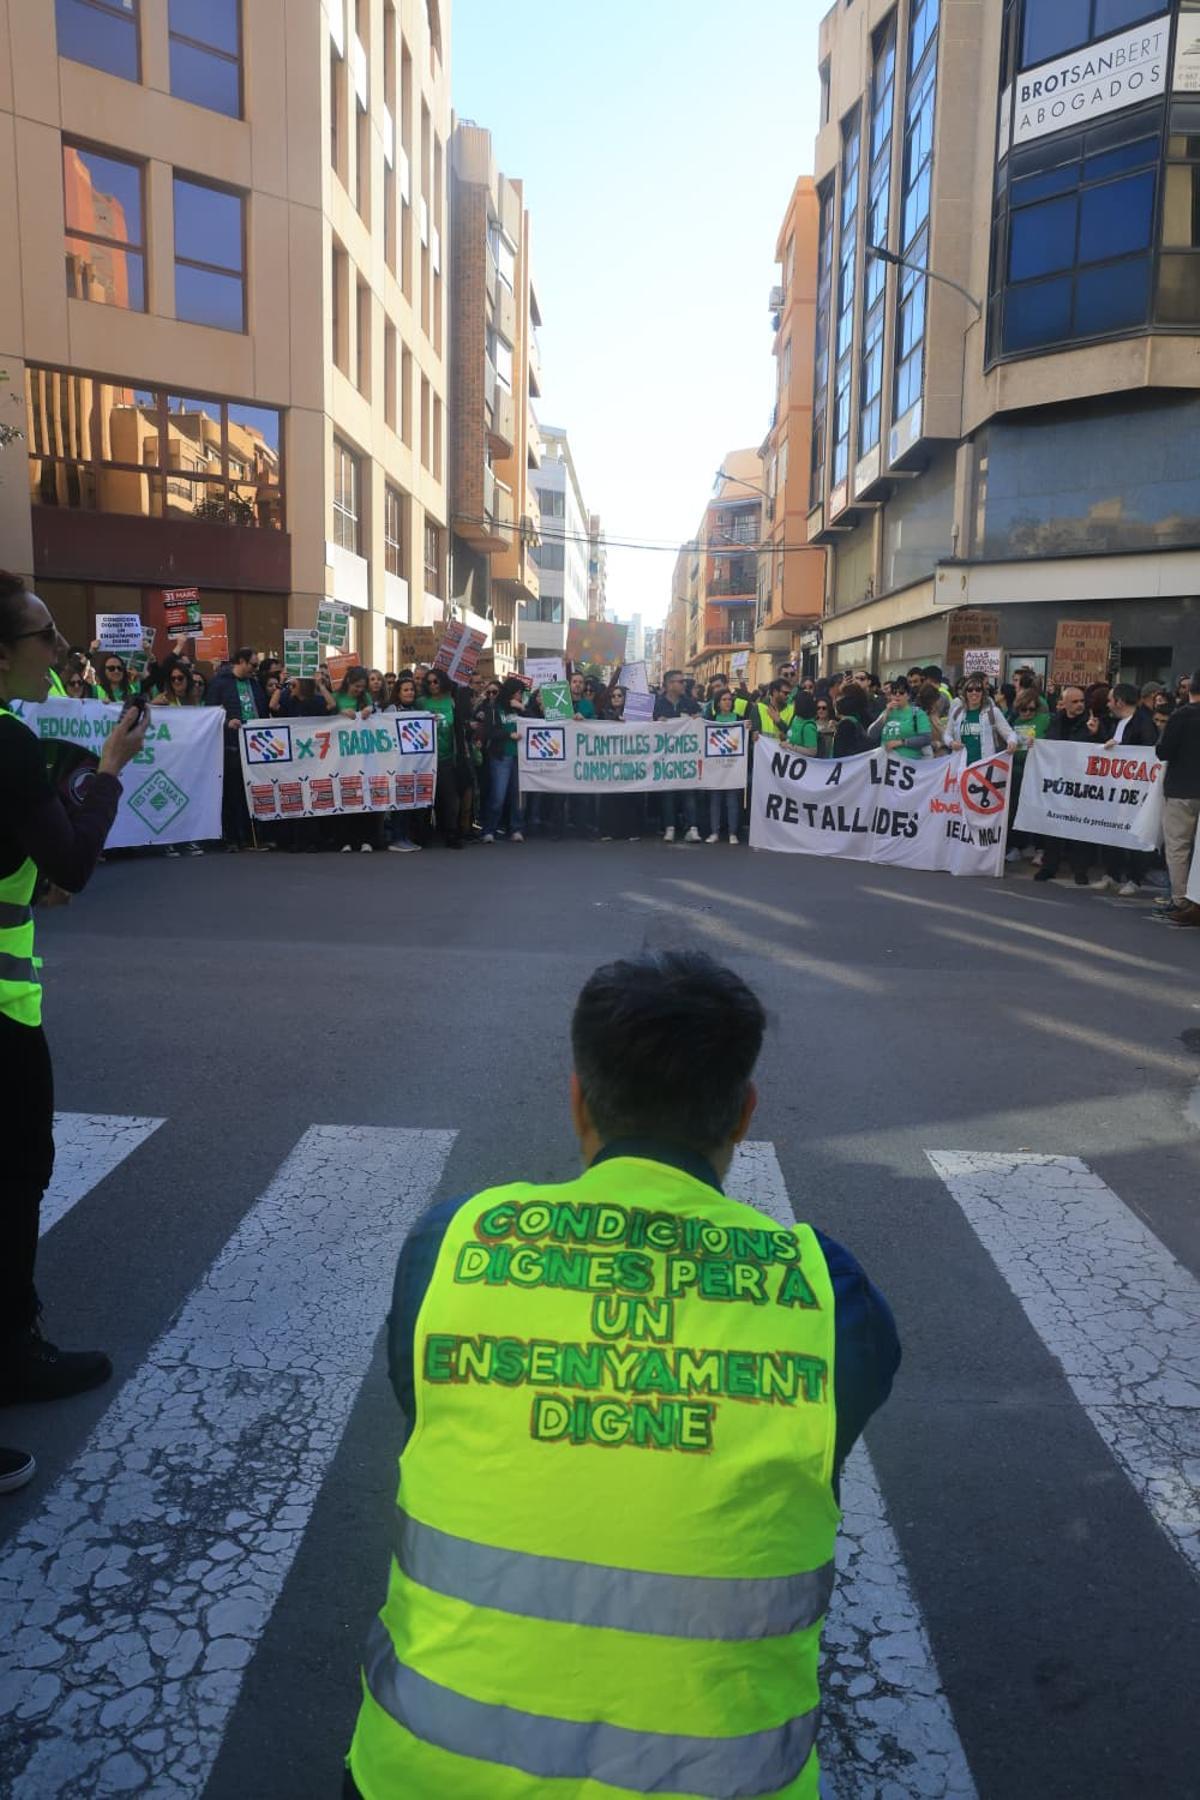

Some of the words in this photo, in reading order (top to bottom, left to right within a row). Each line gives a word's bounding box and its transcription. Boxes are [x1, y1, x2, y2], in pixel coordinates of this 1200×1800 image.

[1019, 65, 1161, 130] ABOGADOS
[1021, 32, 1163, 103] BROTSANBERT
[771, 752, 808, 780] NO
[825, 762, 843, 785] A
[869, 758, 916, 790] LES
[1042, 777, 1104, 801] PÚBLICA
[1119, 788, 1140, 806] DE
[475, 1200, 799, 1262] CONDICIONS
[453, 1242, 654, 1293] DIGNES
[667, 1254, 768, 1305] PER
[776, 1267, 820, 1310] A
[591, 1297, 674, 1344] UN
[423, 1333, 828, 1405] ENSENYAMENT
[530, 1392, 718, 1454] DIGNE
